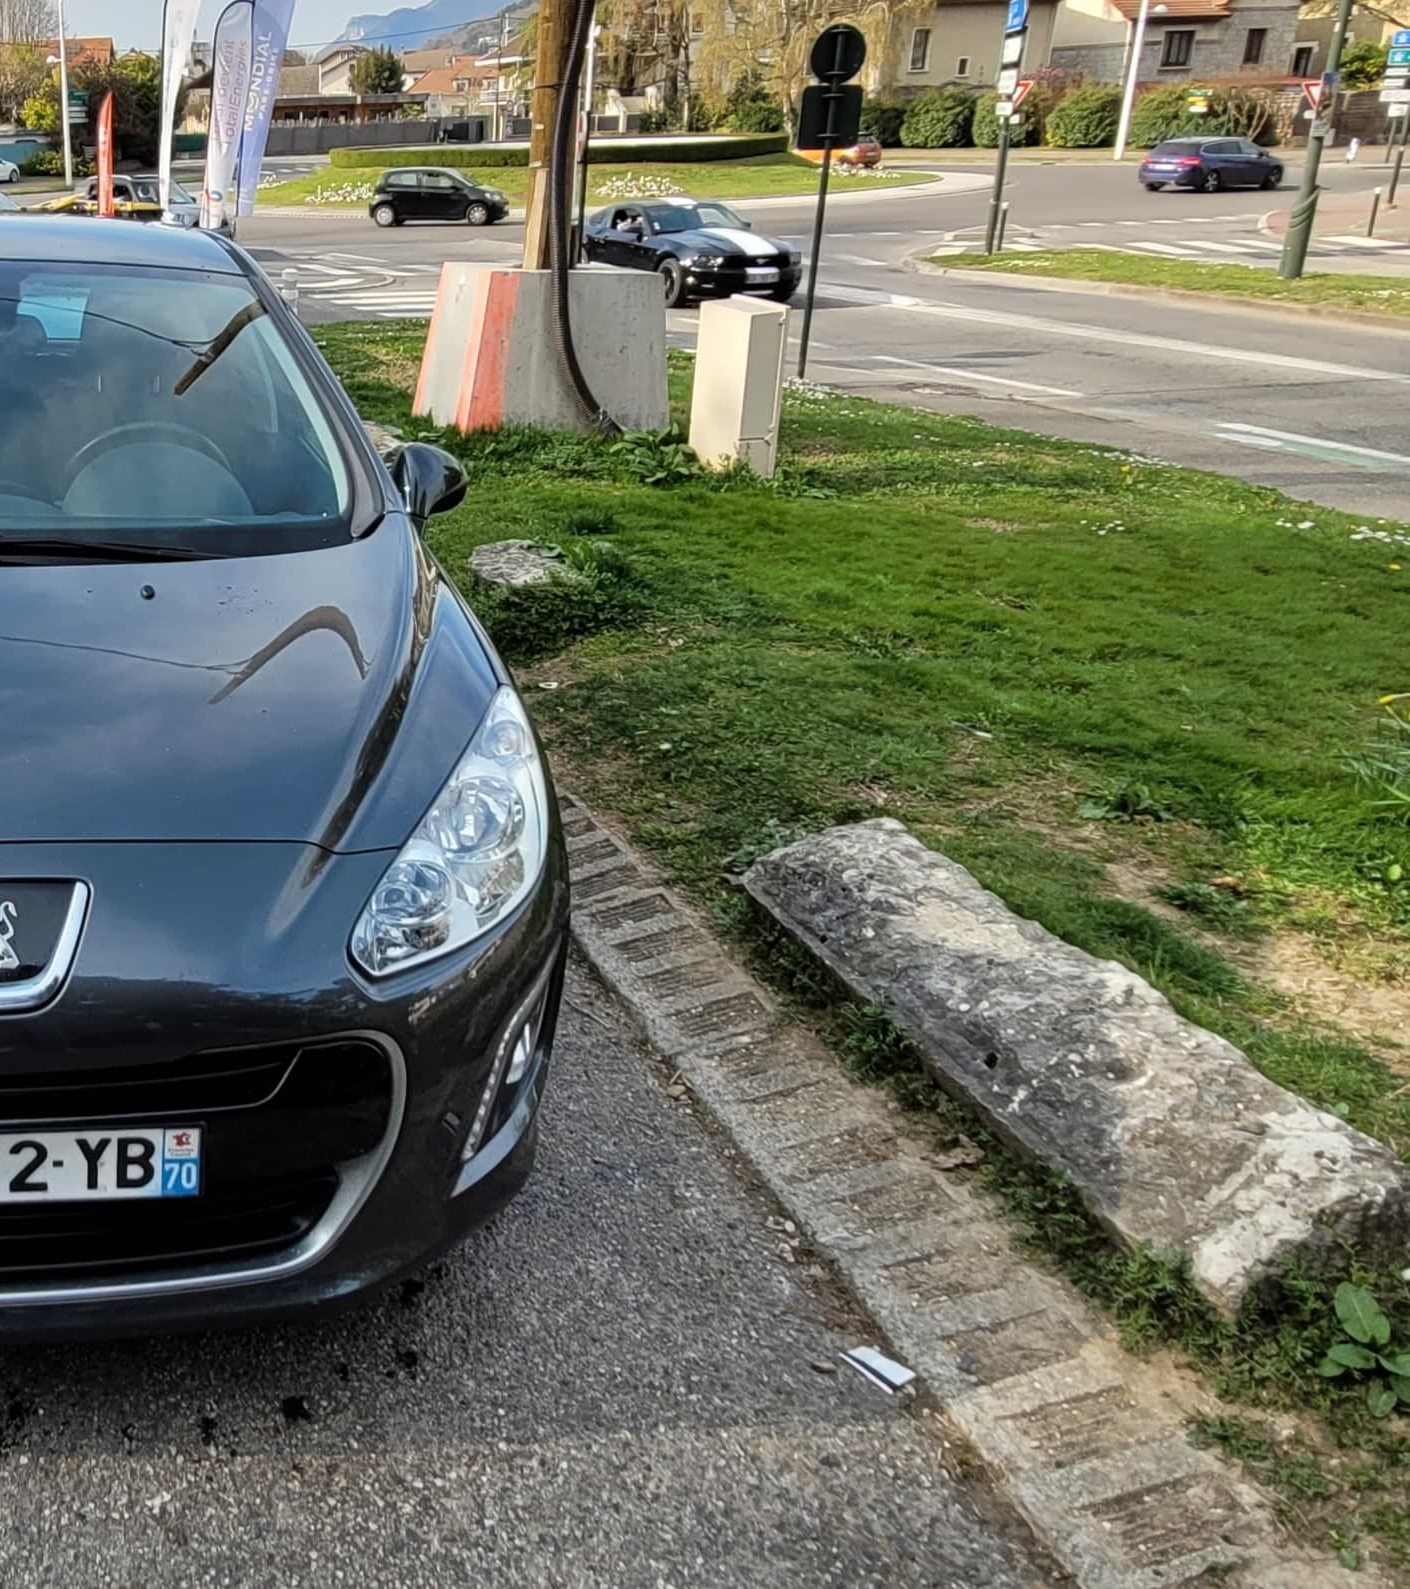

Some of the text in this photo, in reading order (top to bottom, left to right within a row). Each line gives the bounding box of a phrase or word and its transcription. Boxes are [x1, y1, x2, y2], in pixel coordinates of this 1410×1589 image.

[220, 39, 248, 145] TotalEnergies
[244, 31, 271, 132] MONDIAL
[164, 1162, 197, 1190] 70
